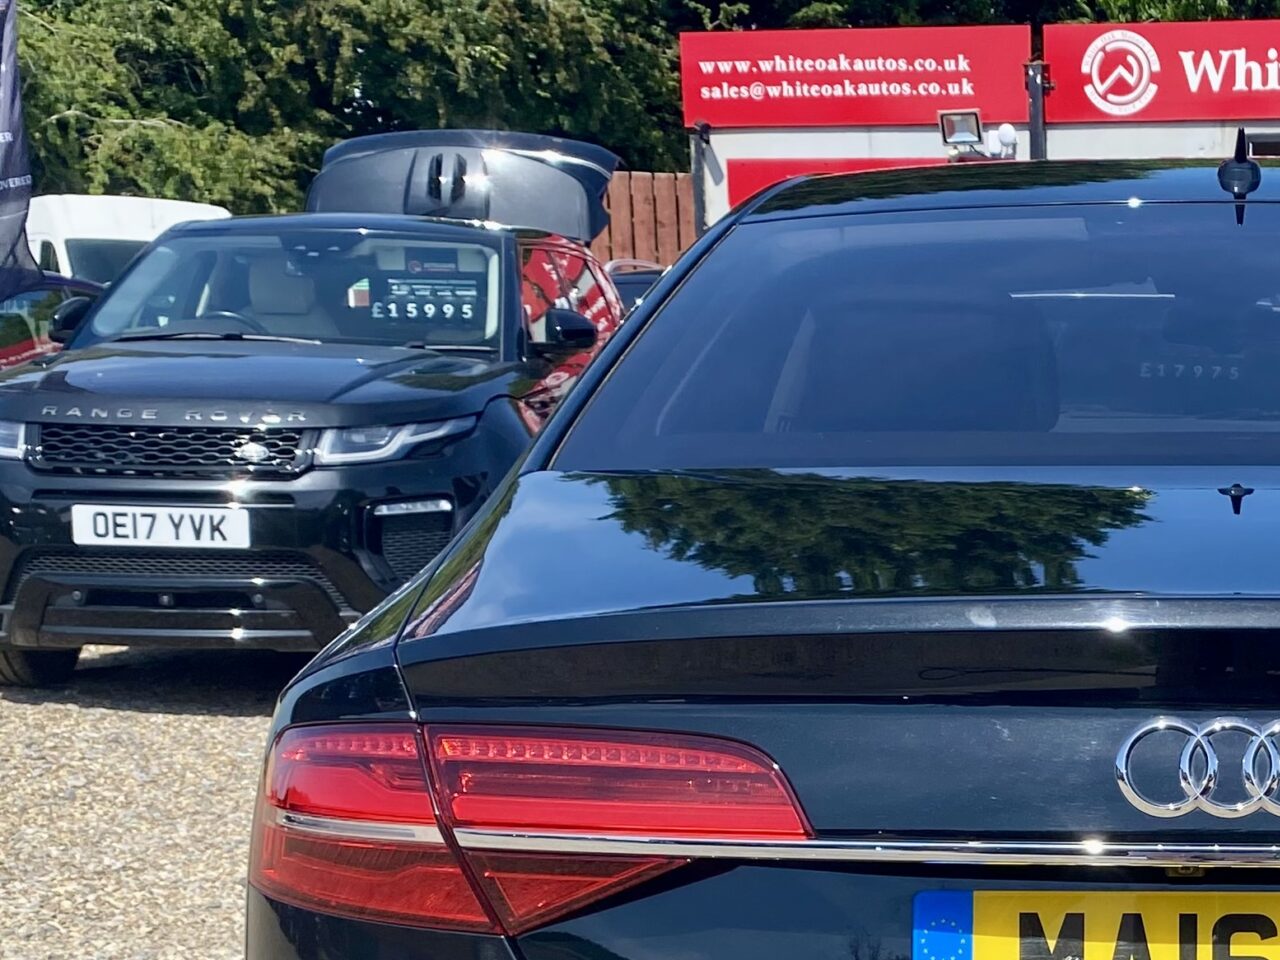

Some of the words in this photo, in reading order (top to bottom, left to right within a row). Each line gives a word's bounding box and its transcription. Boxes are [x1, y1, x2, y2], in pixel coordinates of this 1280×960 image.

[698, 53, 972, 75] www.whiteoakautos.co.uk
[700, 78, 975, 100] sales@whiteoakautos.co.uk
[371, 302, 474, 319] £15995
[41, 405, 159, 420] RANGE
[92, 511, 157, 540] OE17
[168, 513, 228, 542] YVK
